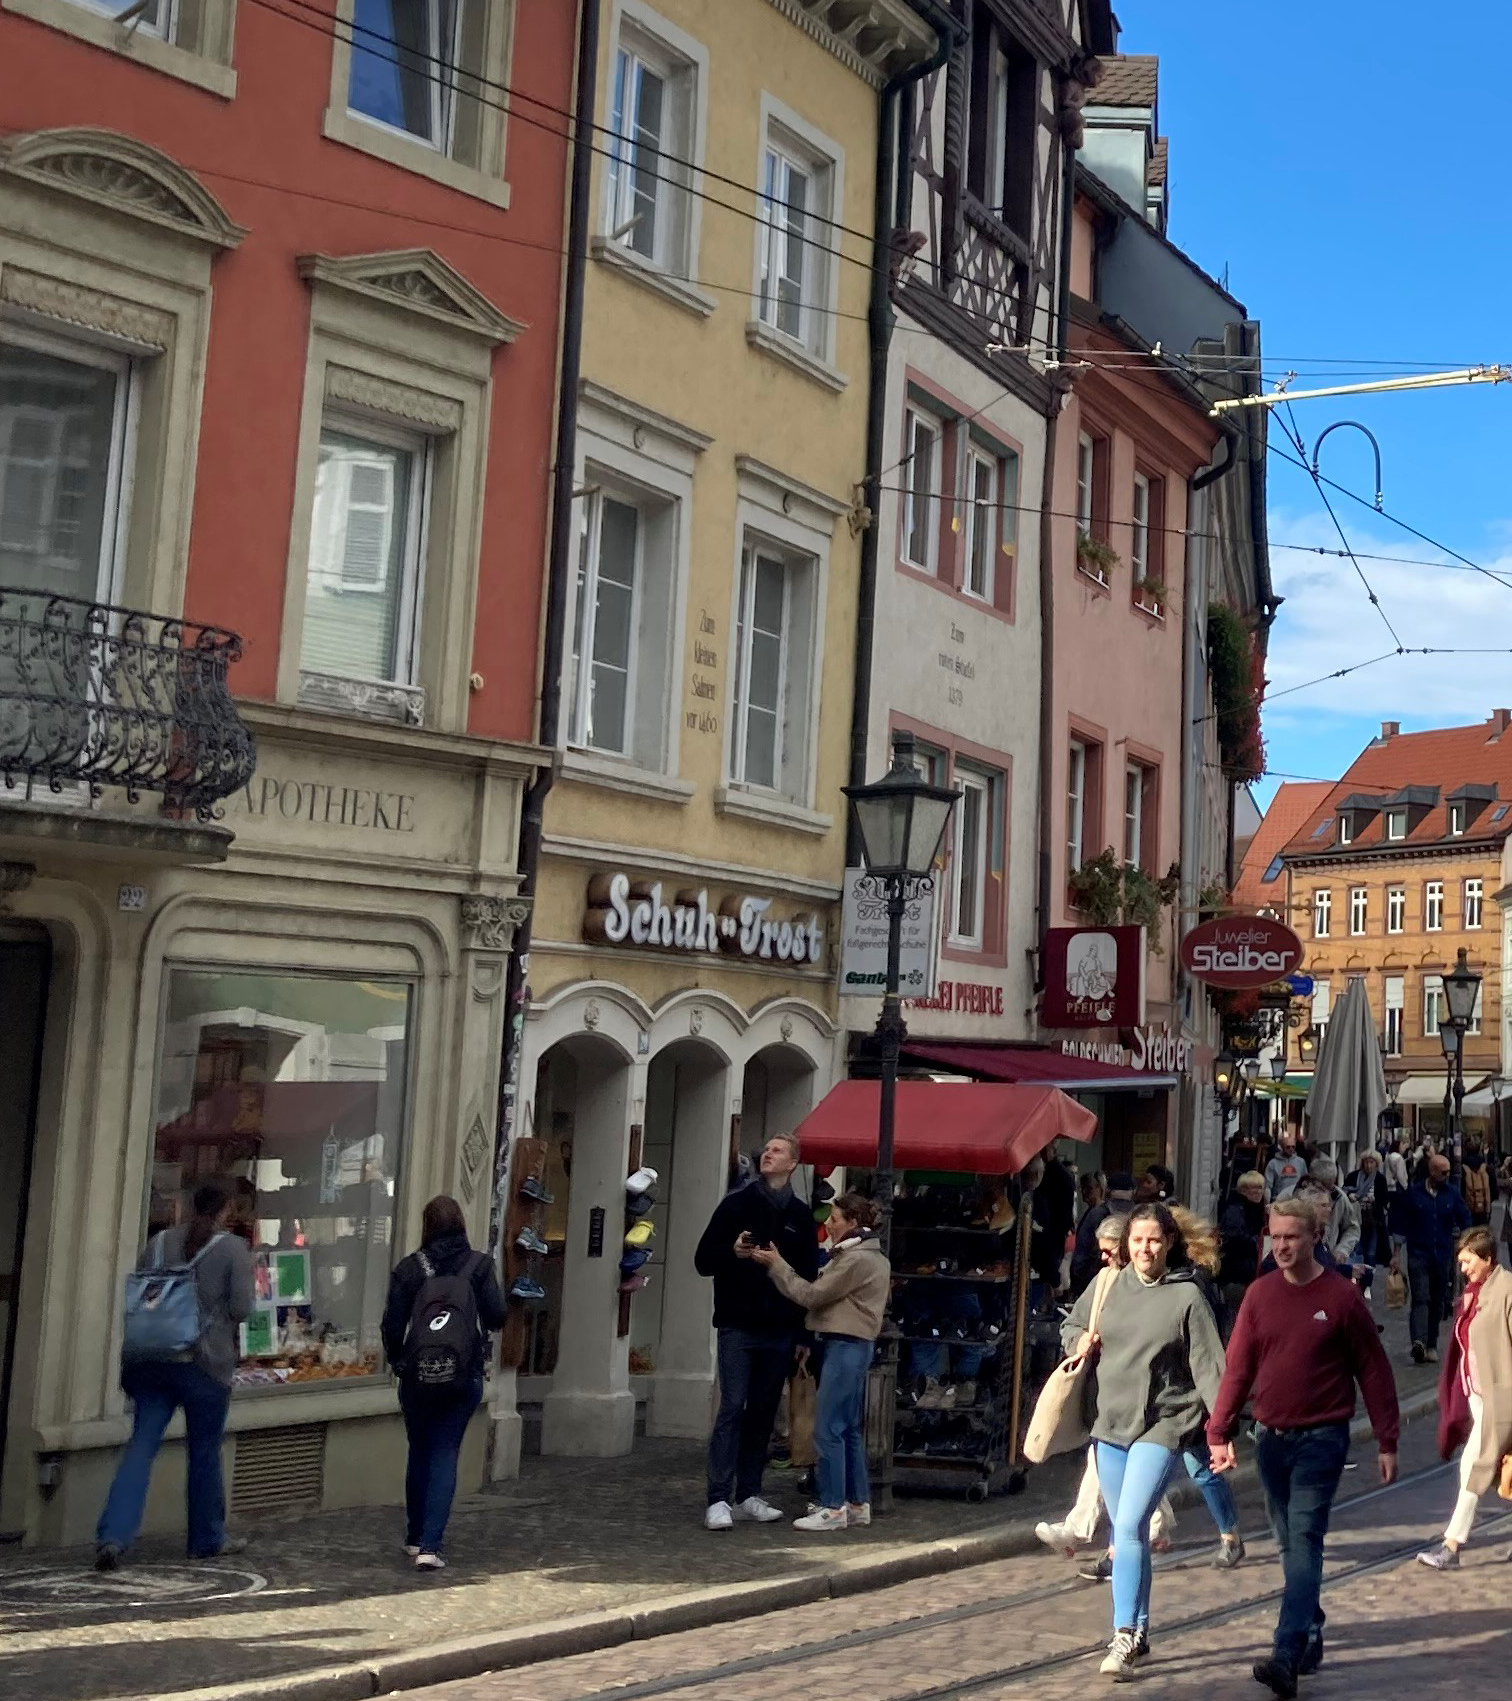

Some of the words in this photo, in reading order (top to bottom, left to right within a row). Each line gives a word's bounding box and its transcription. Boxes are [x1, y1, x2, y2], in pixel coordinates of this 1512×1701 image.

[234, 777, 415, 832] APOTHEKE
[1209, 926, 1272, 945] Juwelier
[1191, 944, 1294, 971] Steiber
[845, 972, 906, 985] Gant
[1131, 1020, 1193, 1072] Steiber
